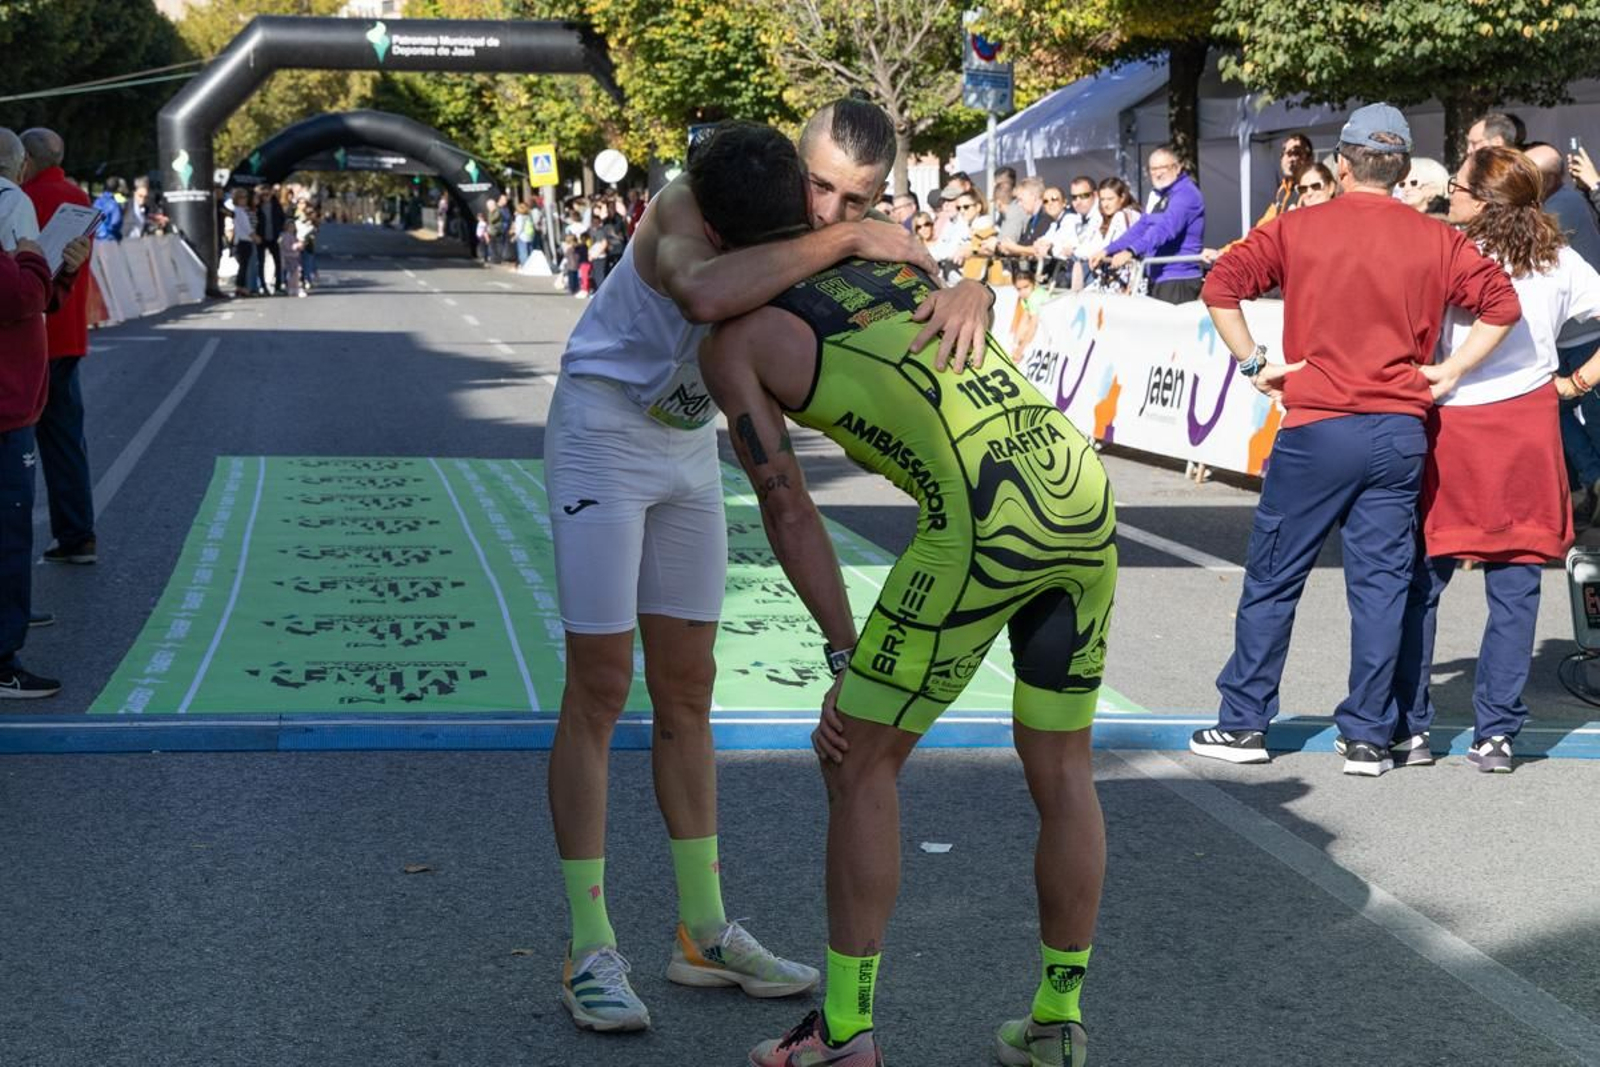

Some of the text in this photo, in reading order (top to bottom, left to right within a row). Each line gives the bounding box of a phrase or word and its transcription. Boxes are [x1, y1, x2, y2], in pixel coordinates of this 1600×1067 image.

[391, 45, 436, 57] Deportes
[437, 46, 450, 56] de
[439, 35, 485, 48] Municipal
[486, 36, 500, 47] de
[957, 369, 1020, 409] 1153
[987, 422, 1065, 462] RAFITA
[833, 411, 948, 532] AMBASSADOR
